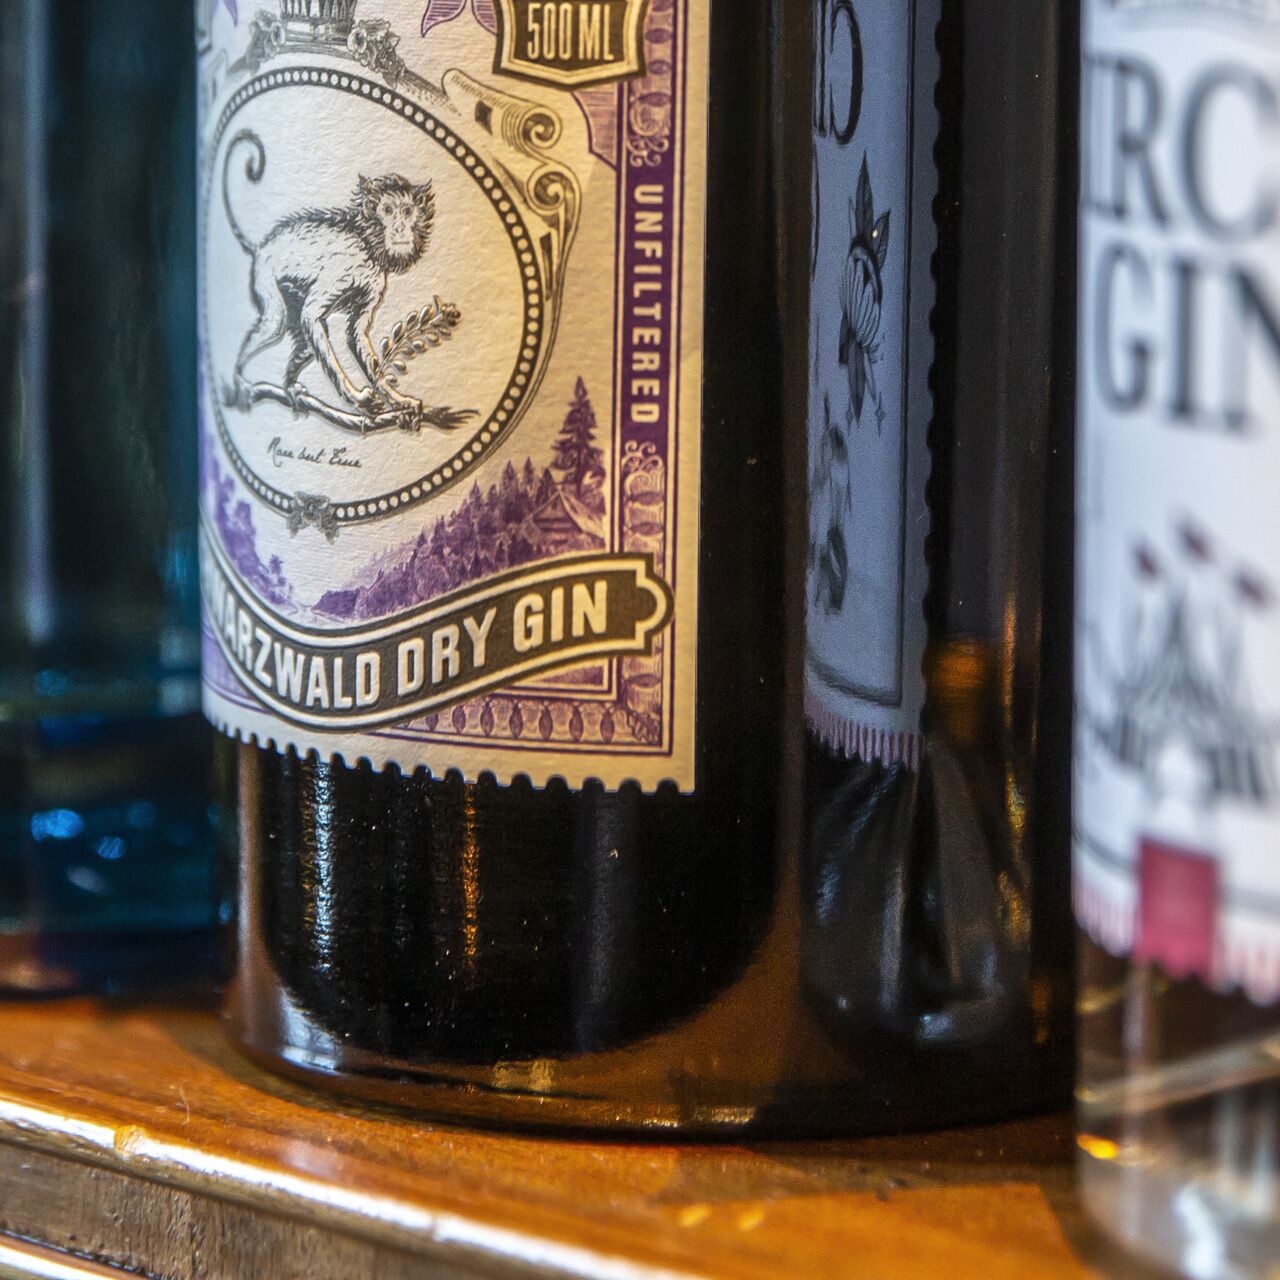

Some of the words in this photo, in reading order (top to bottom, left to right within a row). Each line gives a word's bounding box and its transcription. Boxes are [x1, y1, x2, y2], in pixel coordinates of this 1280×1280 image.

[527, 2, 573, 60] 500
[578, 3, 615, 61] ML
[630, 183, 664, 424] UNFILTERED
[397, 606, 498, 697] DRY
[512, 579, 608, 653] GIN
